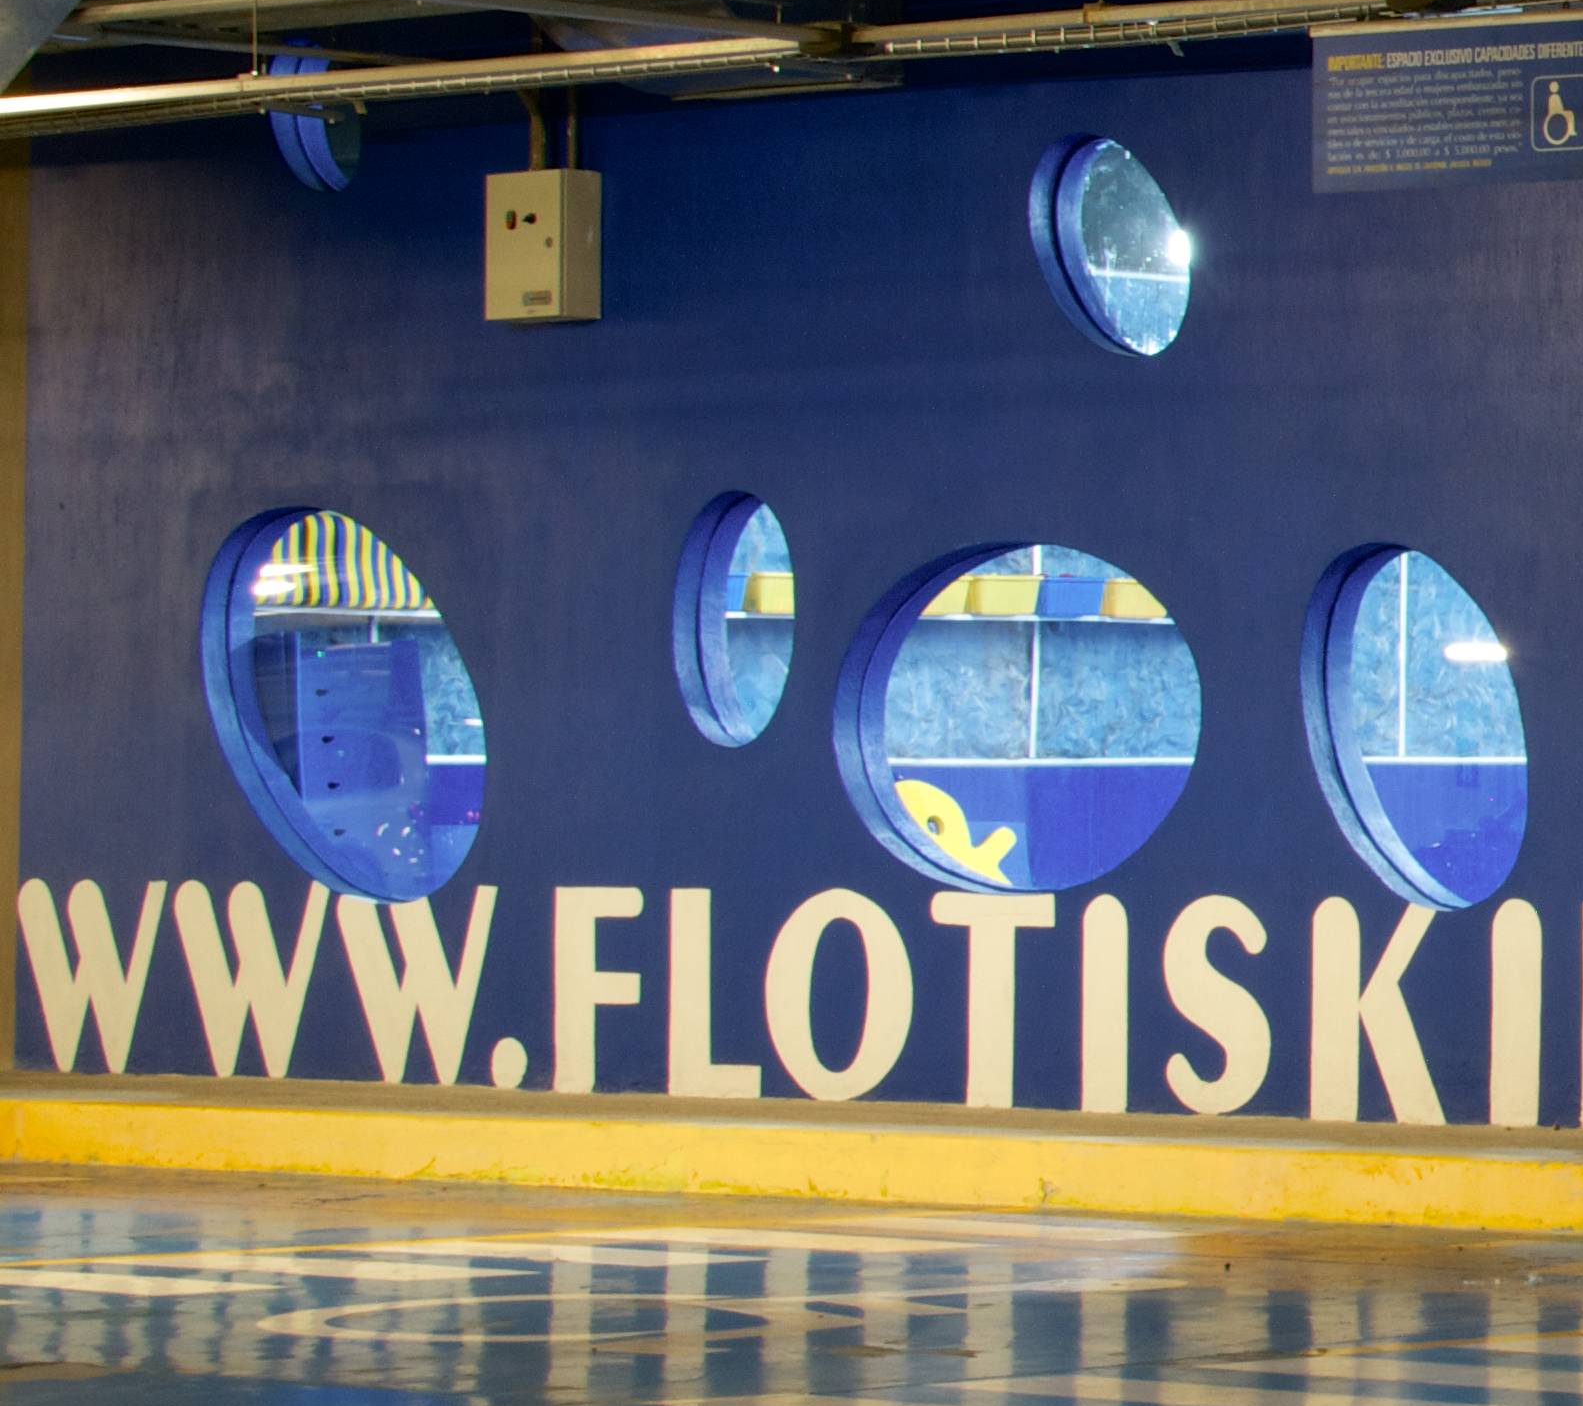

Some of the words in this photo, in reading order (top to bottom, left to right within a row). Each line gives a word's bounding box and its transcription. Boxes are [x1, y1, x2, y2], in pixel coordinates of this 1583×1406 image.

[1387, 51, 1422, 68] ESPACIO
[1425, 47, 1473, 66] EXCLUSIVO
[1475, 44, 1536, 63] CAPACIDADES
